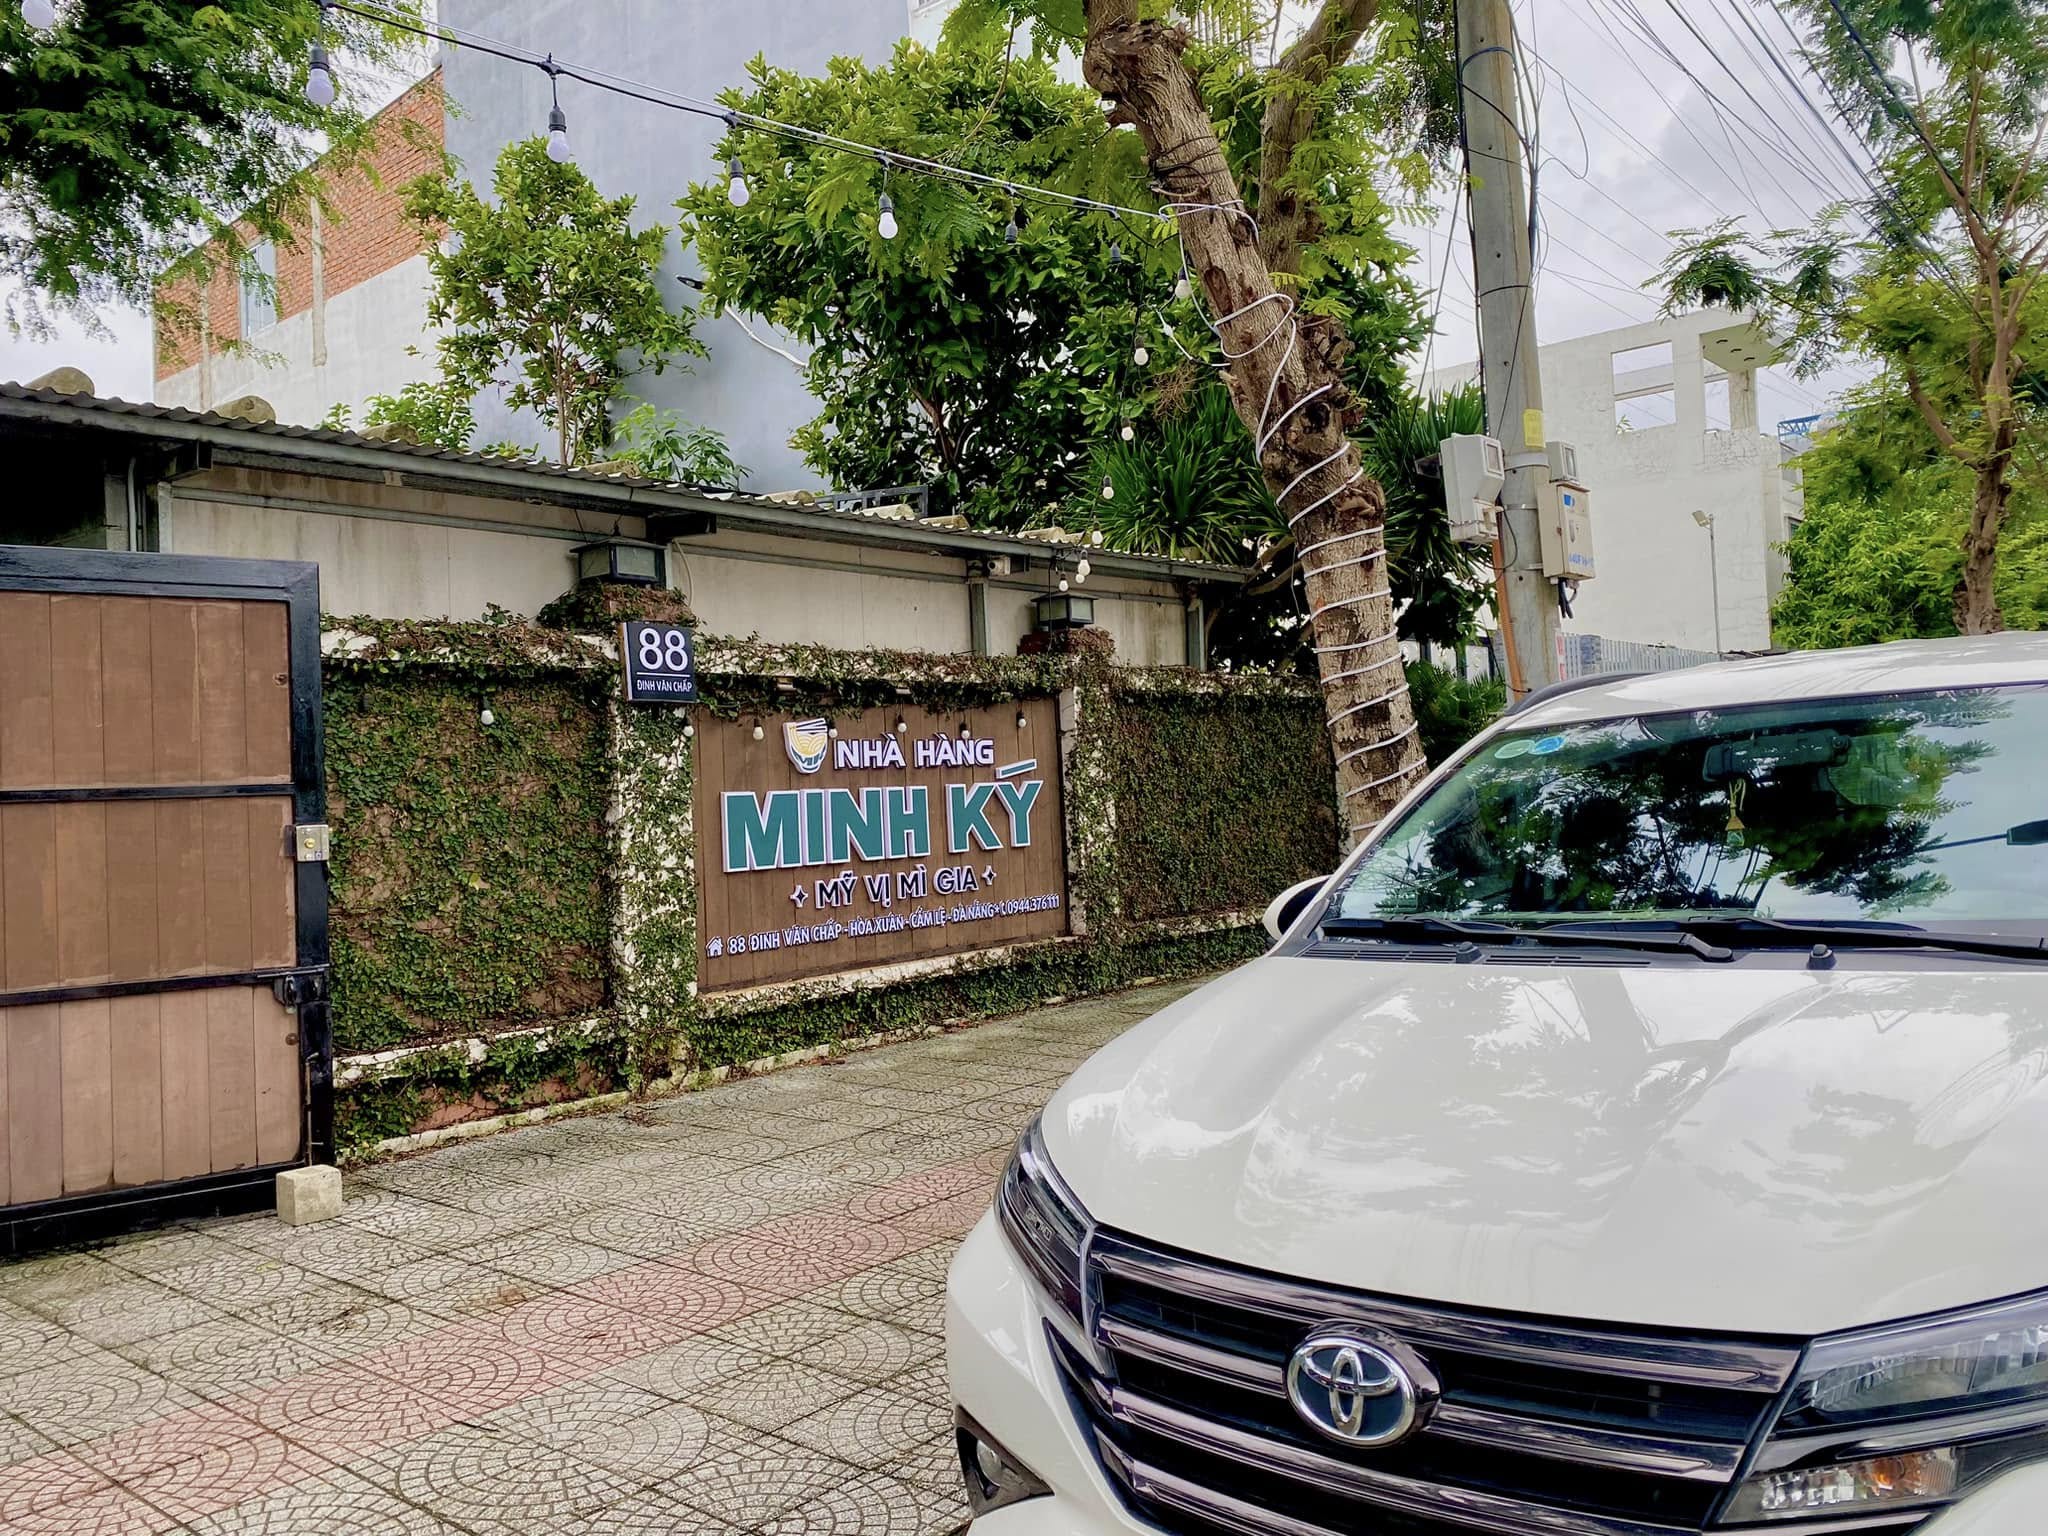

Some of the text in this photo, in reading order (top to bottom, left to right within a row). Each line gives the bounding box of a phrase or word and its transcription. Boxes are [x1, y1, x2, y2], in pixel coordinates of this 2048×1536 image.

[639, 627, 688, 671] 88
[636, 678, 692, 692] ĐINH VĂN CHẤP
[834, 732, 994, 769] NHÀ HÀNG
[721, 759, 1043, 872] MINH KÝ
[815, 863, 979, 909] MỸ VỊ MÌ GIA
[727, 935, 747, 955] 88
[749, 931, 780, 953] ĐINH
[782, 924, 811, 946] VĂN
[811, 918, 842, 943] CHẤP
[874, 911, 904, 933] XUÂN
[934, 905, 946, 927] LỆ
[951, 901, 967, 923] ĐÀ
